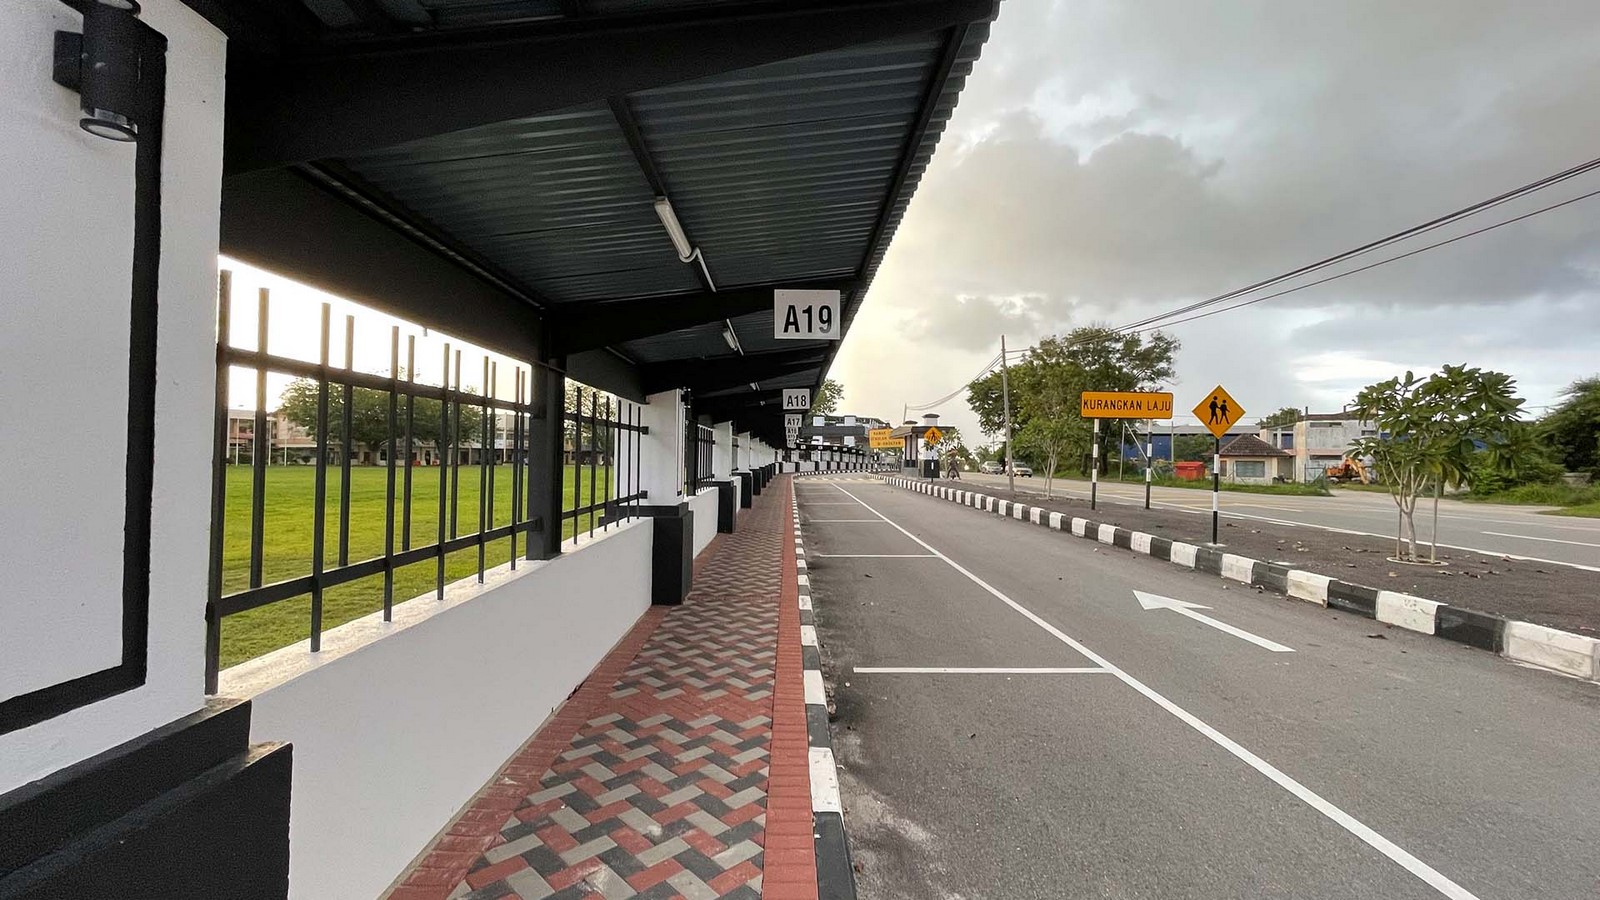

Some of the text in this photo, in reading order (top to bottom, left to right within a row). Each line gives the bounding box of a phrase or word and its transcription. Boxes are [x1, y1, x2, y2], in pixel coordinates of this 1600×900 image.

[783, 304, 832, 334] A19
[786, 394, 807, 407] A18
[1083, 399, 1171, 411] KURANGKAN LAJU
[787, 418, 800, 426] A17
